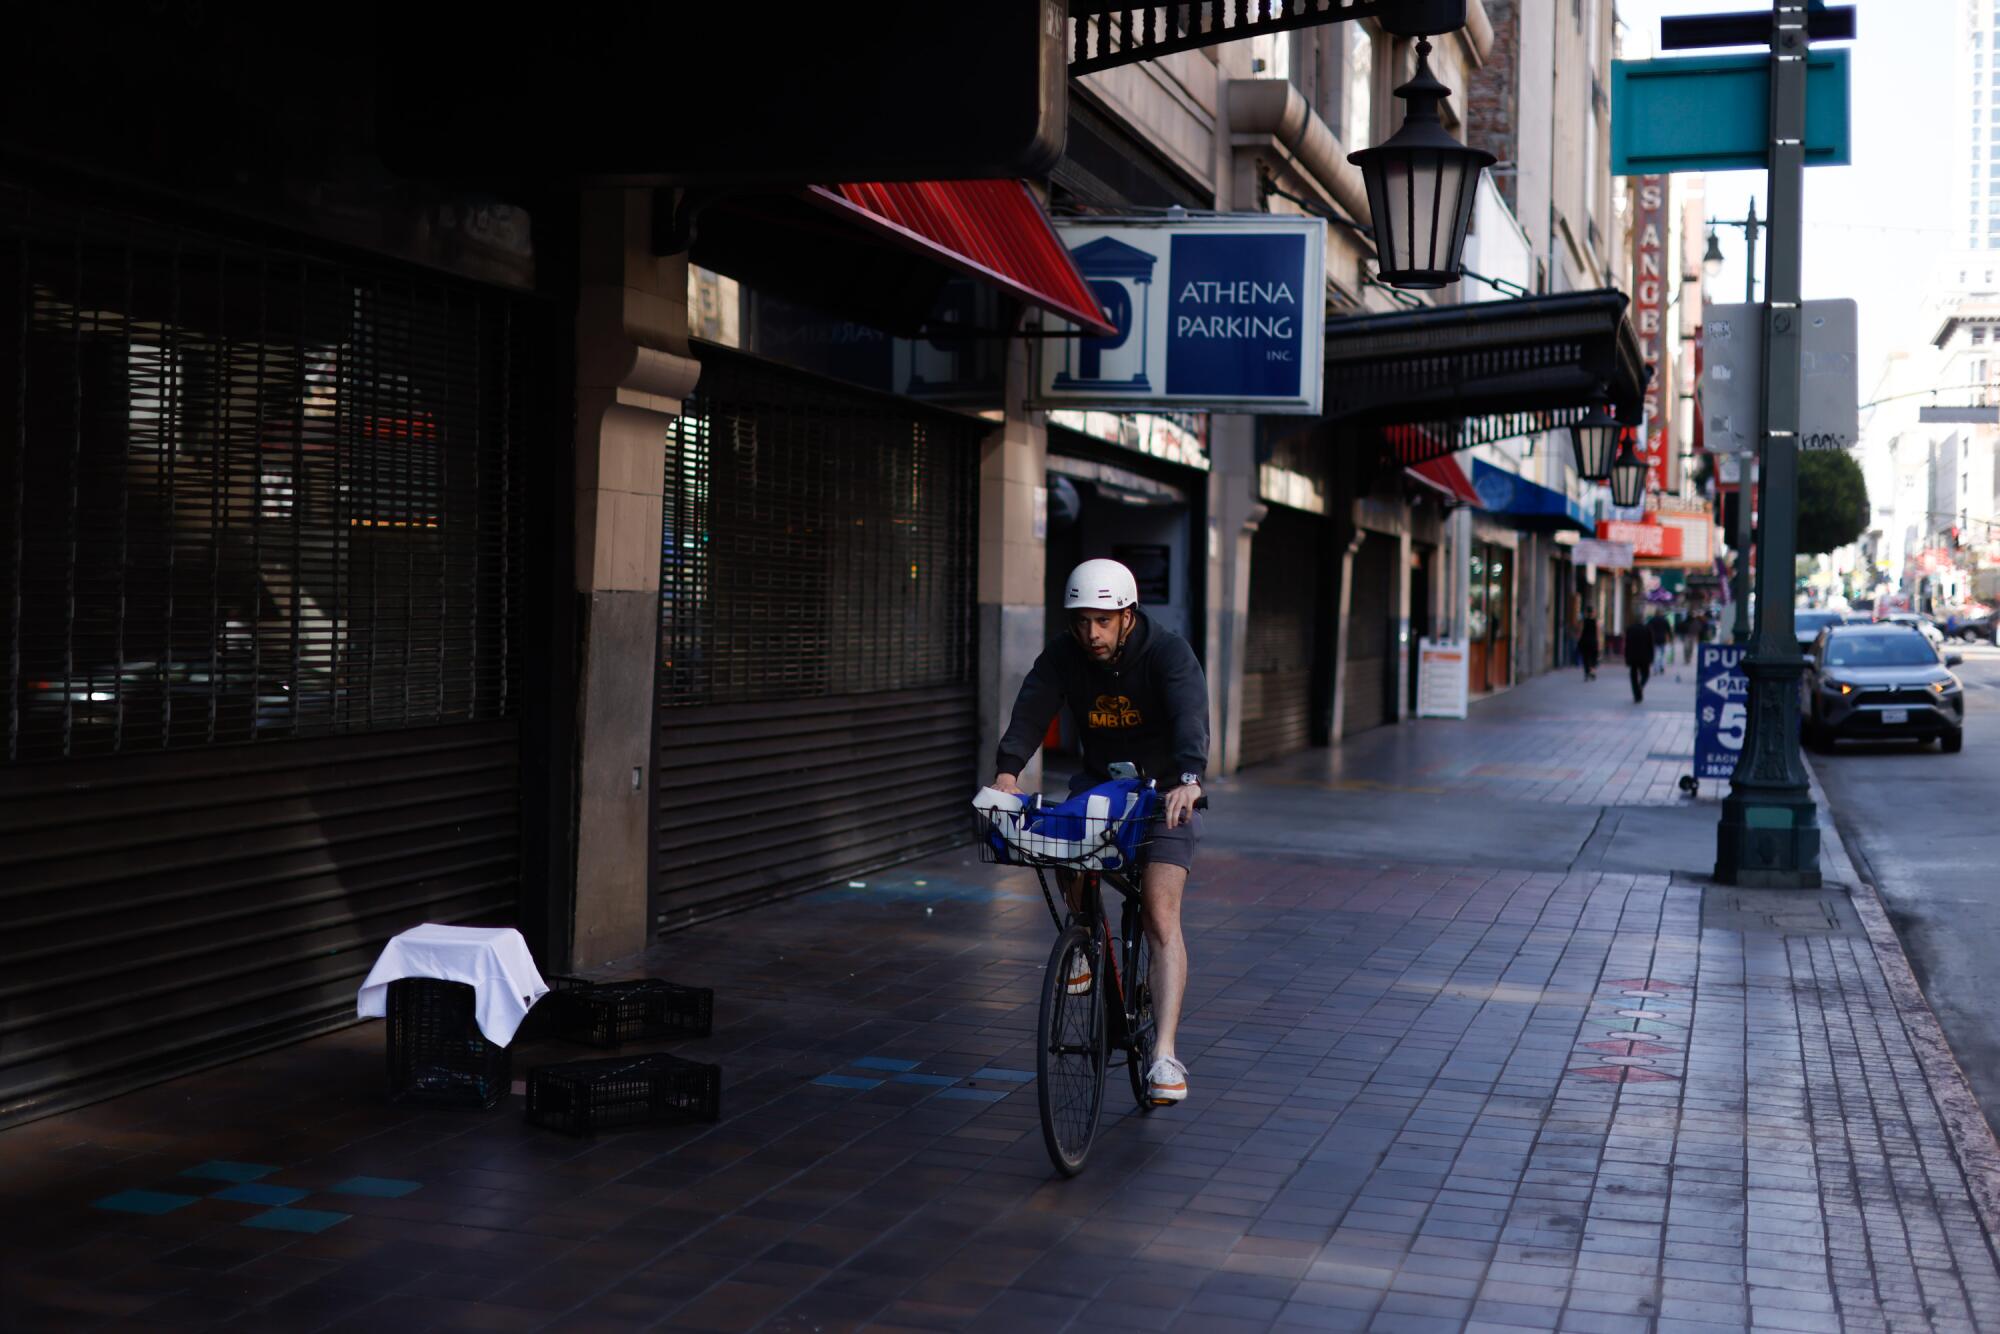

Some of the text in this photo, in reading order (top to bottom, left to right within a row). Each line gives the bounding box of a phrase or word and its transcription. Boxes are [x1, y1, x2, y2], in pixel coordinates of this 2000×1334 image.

[1178, 280, 1296, 305] ATHENA
[1176, 315, 1293, 339] PARKING
[1704, 649, 1747, 669] PU
[1717, 702, 1747, 751] 5
